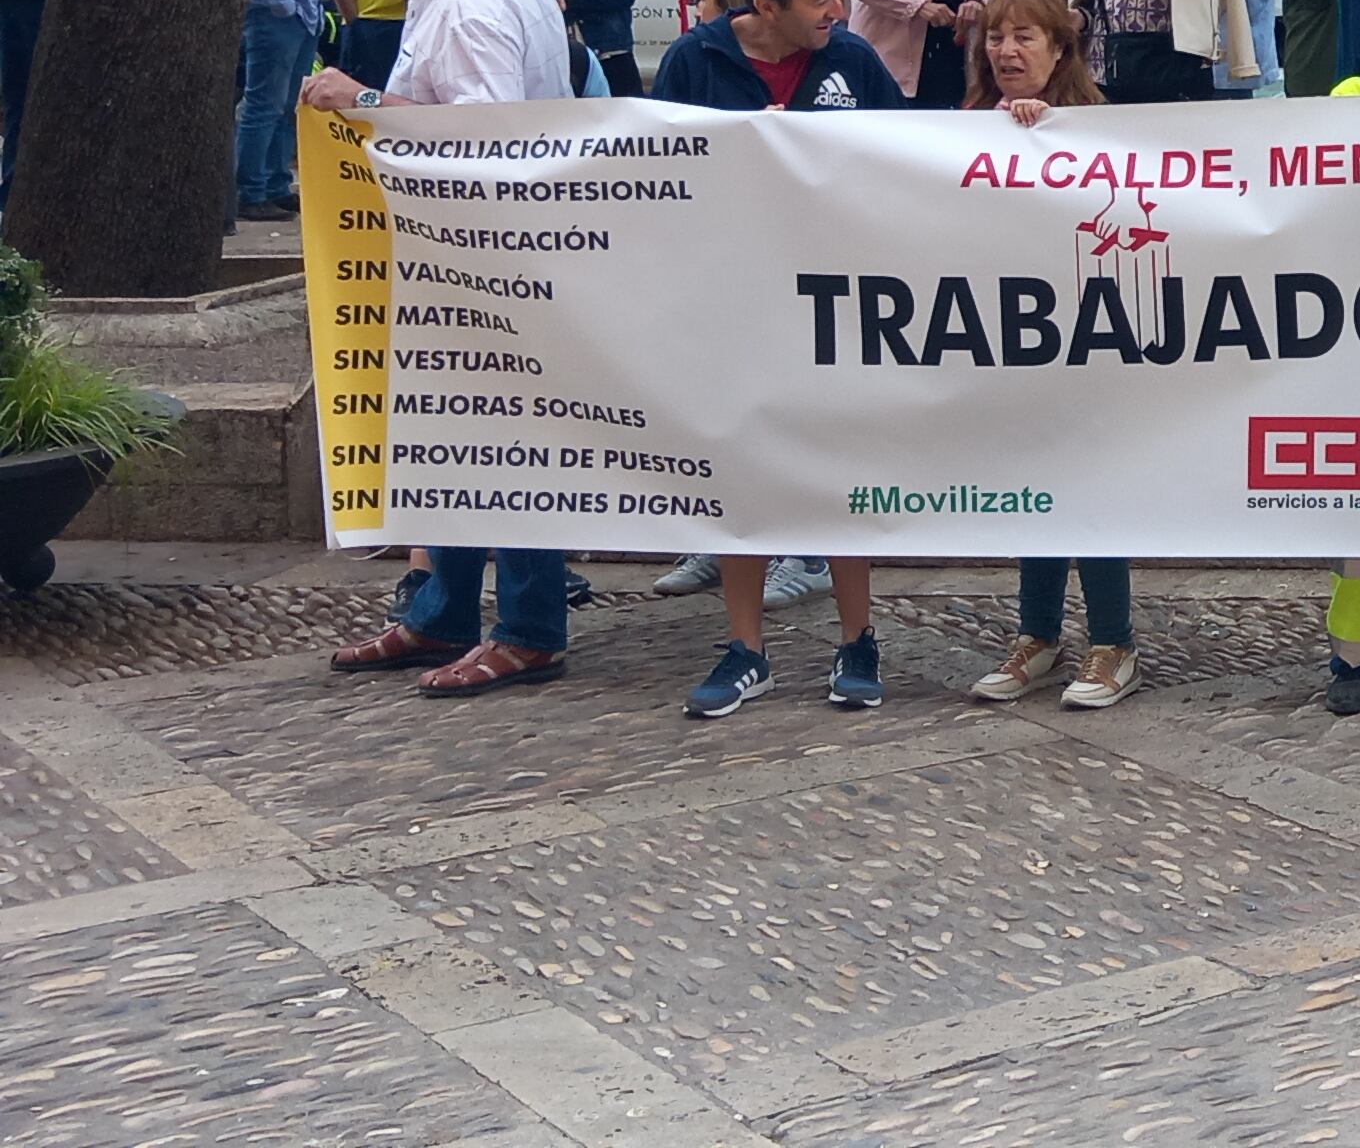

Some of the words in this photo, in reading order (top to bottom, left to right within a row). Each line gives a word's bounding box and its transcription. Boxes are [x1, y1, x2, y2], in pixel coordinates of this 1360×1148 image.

[328, 121, 367, 149] SIN
[373, 133, 573, 161] CONCILIACIÓN
[579, 135, 711, 158] FAMILIAR
[339, 160, 377, 186] SIN
[379, 172, 487, 201] CARRERA
[495, 179, 693, 203] PROFESIONAL
[961, 148, 1248, 194] ALCALDE,
[338, 209, 388, 231] SIN
[393, 213, 610, 252] RECLASIFICACIÓN
[336, 259, 388, 282] SIN
[396, 260, 554, 301] VALORACIÓN
[334, 304, 386, 326] SIN
[396, 305, 519, 336] MATERIAL
[333, 348, 385, 371] SIN
[394, 349, 544, 376] VESTUARIO
[332, 394, 384, 416] SIN
[393, 394, 524, 418] MEJORAS
[532, 395, 647, 430] SOCIALES
[331, 443, 382, 467] SIN
[392, 440, 549, 468] PROVISIÓN
[559, 447, 595, 470] DE
[603, 449, 714, 479] PUESTOS
[331, 488, 380, 512] SIN
[390, 487, 609, 515] INSTALACIONES
[617, 492, 724, 519] DIGNAS
[848, 484, 1055, 514] #Movilizate
[1246, 493, 1329, 510] servicios
[1333, 496, 1344, 509] a
